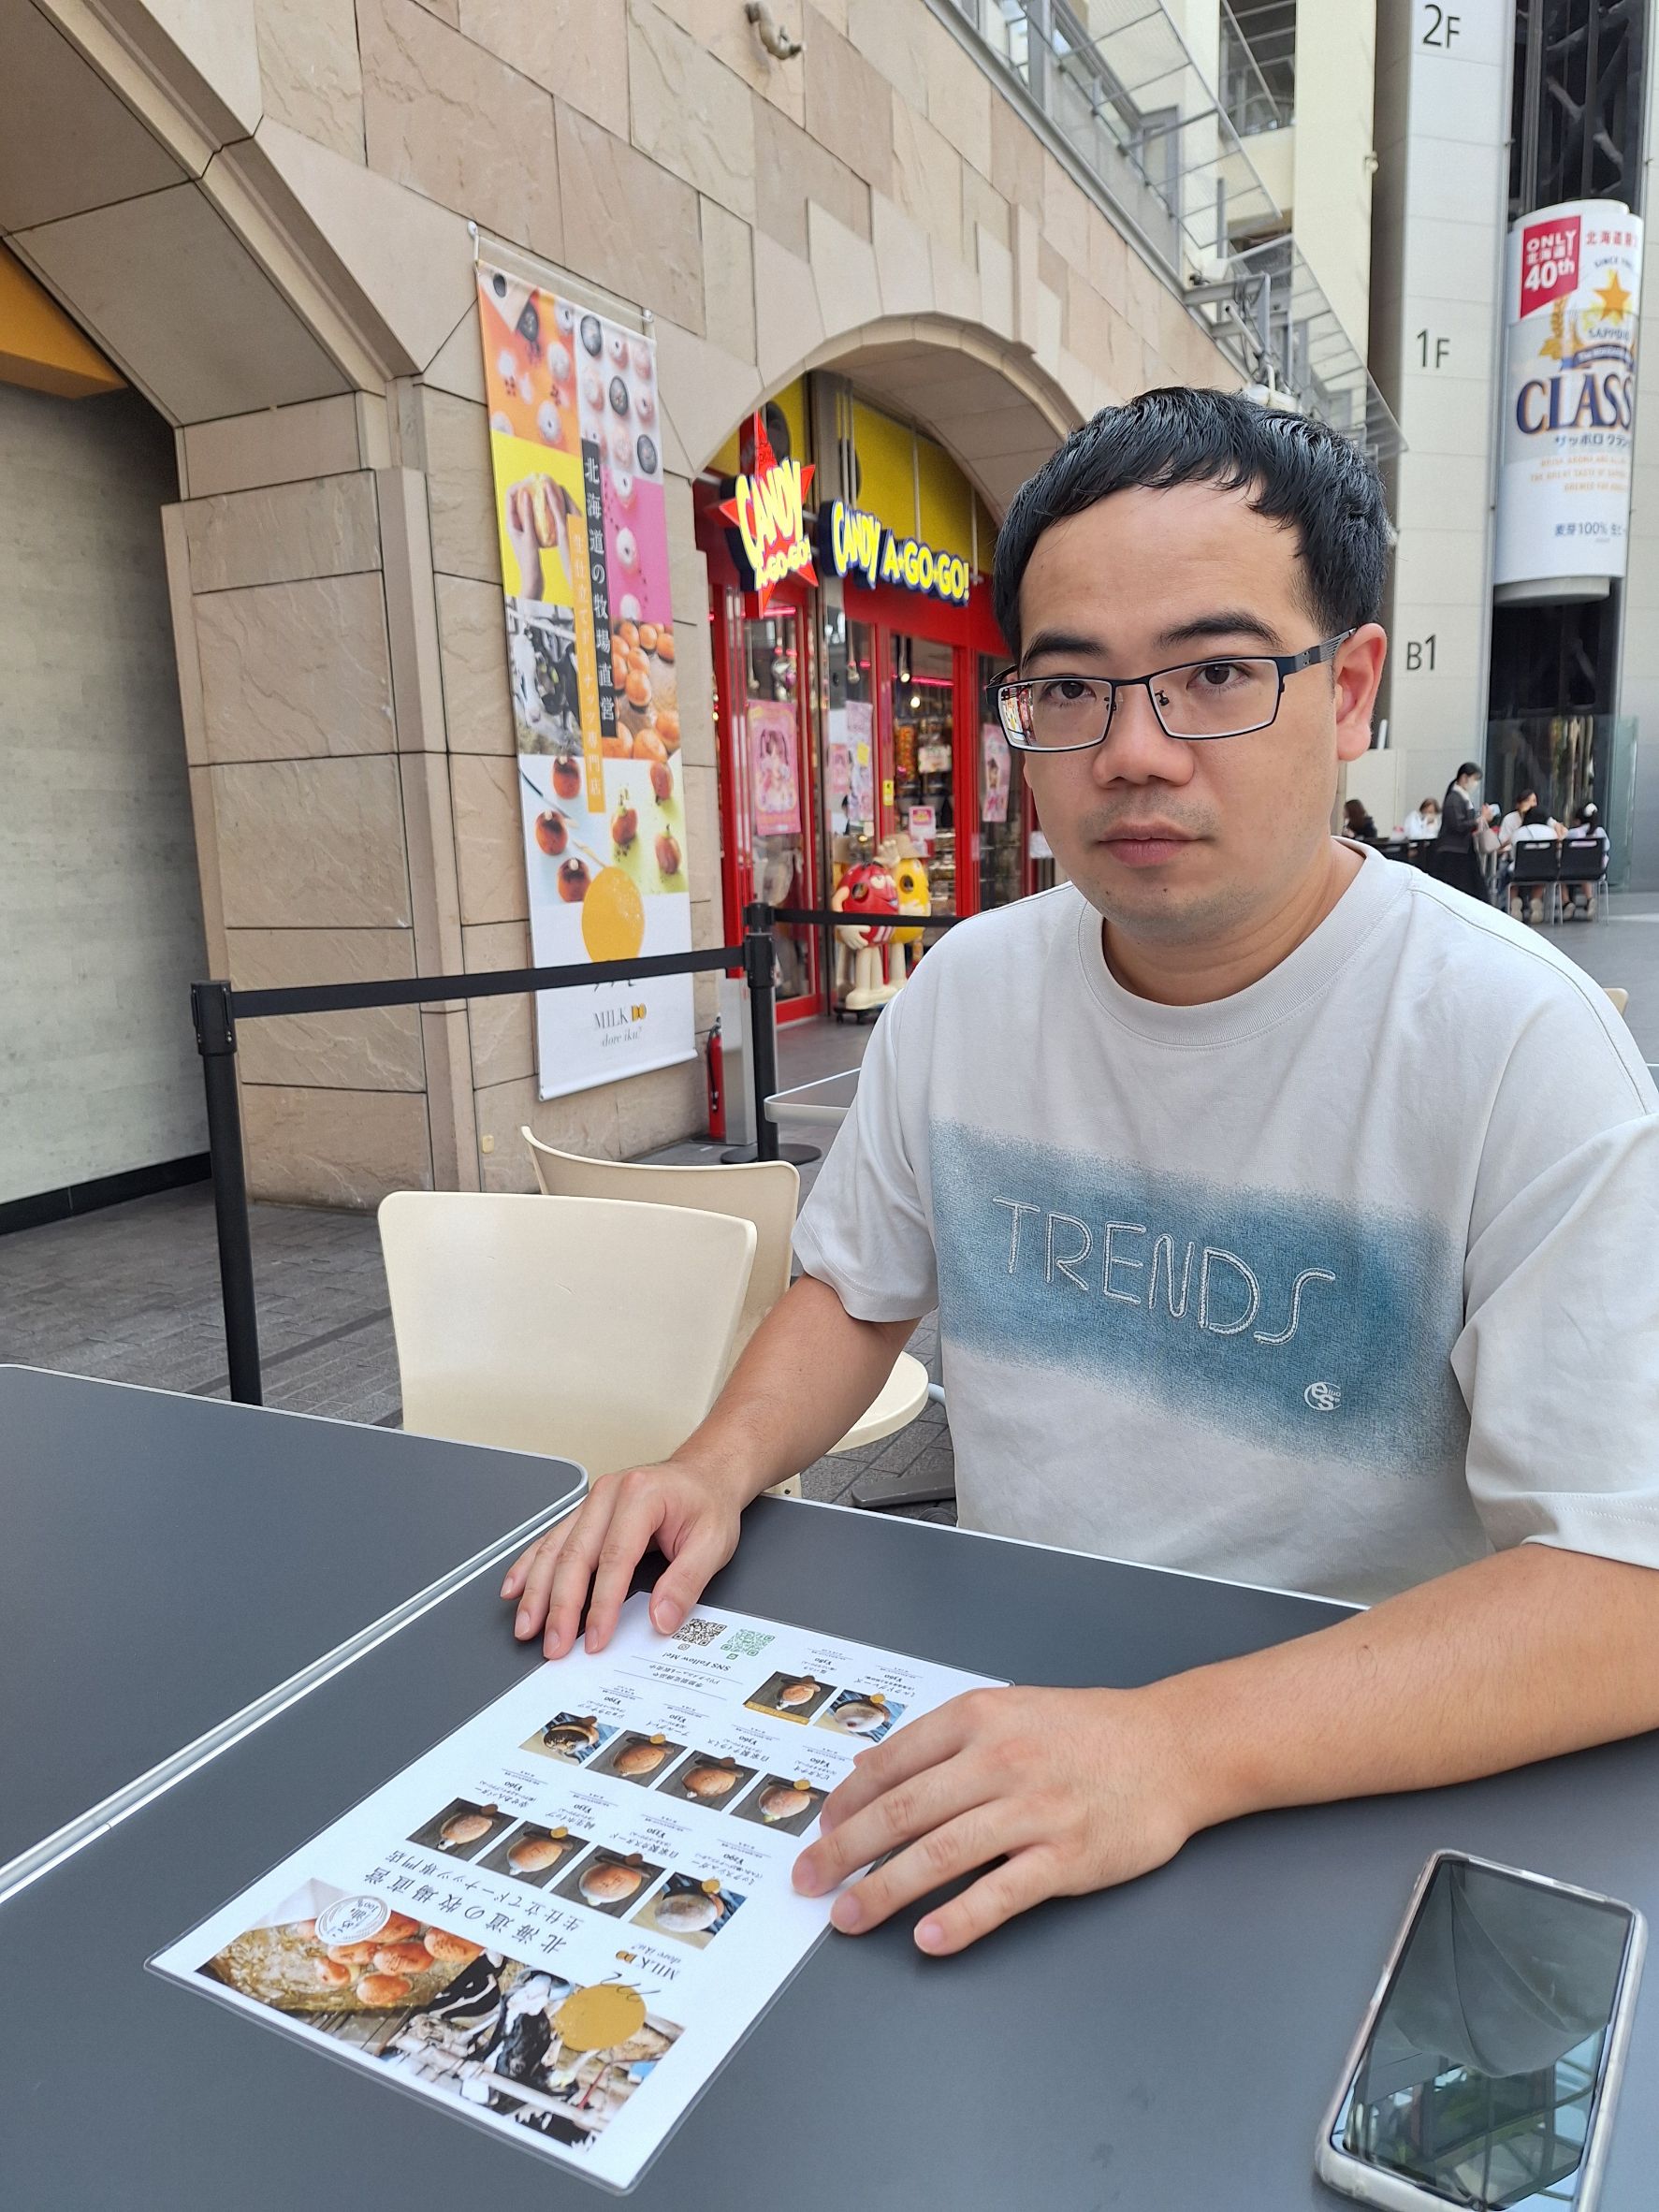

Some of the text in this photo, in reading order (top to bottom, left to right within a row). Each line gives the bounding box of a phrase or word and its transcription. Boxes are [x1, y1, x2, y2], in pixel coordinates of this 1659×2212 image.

[1423, 4, 1461, 48] 2F
[1526, 229, 1577, 255] ONLY
[1524, 258, 1576, 292] 40th
[1417, 329, 1449, 368] 1F
[735, 458, 803, 570] CANDY
[832, 500, 881, 589] CANDY
[584, 457, 615, 721] 北海道の牧場直営
[1406, 633, 1436, 671] B1
[593, 1008, 629, 1028] MILK
[993, 1195, 1336, 1346] TRENDS
[679, 1656, 711, 1666] Follow
[708, 1662, 732, 1671] SNS
[384, 1848, 585, 1932] 生仕立てドーナッツ専門店
[359, 1865, 569, 1956] 北海道の牧場直営
[634, 1956, 680, 1980] MILK
